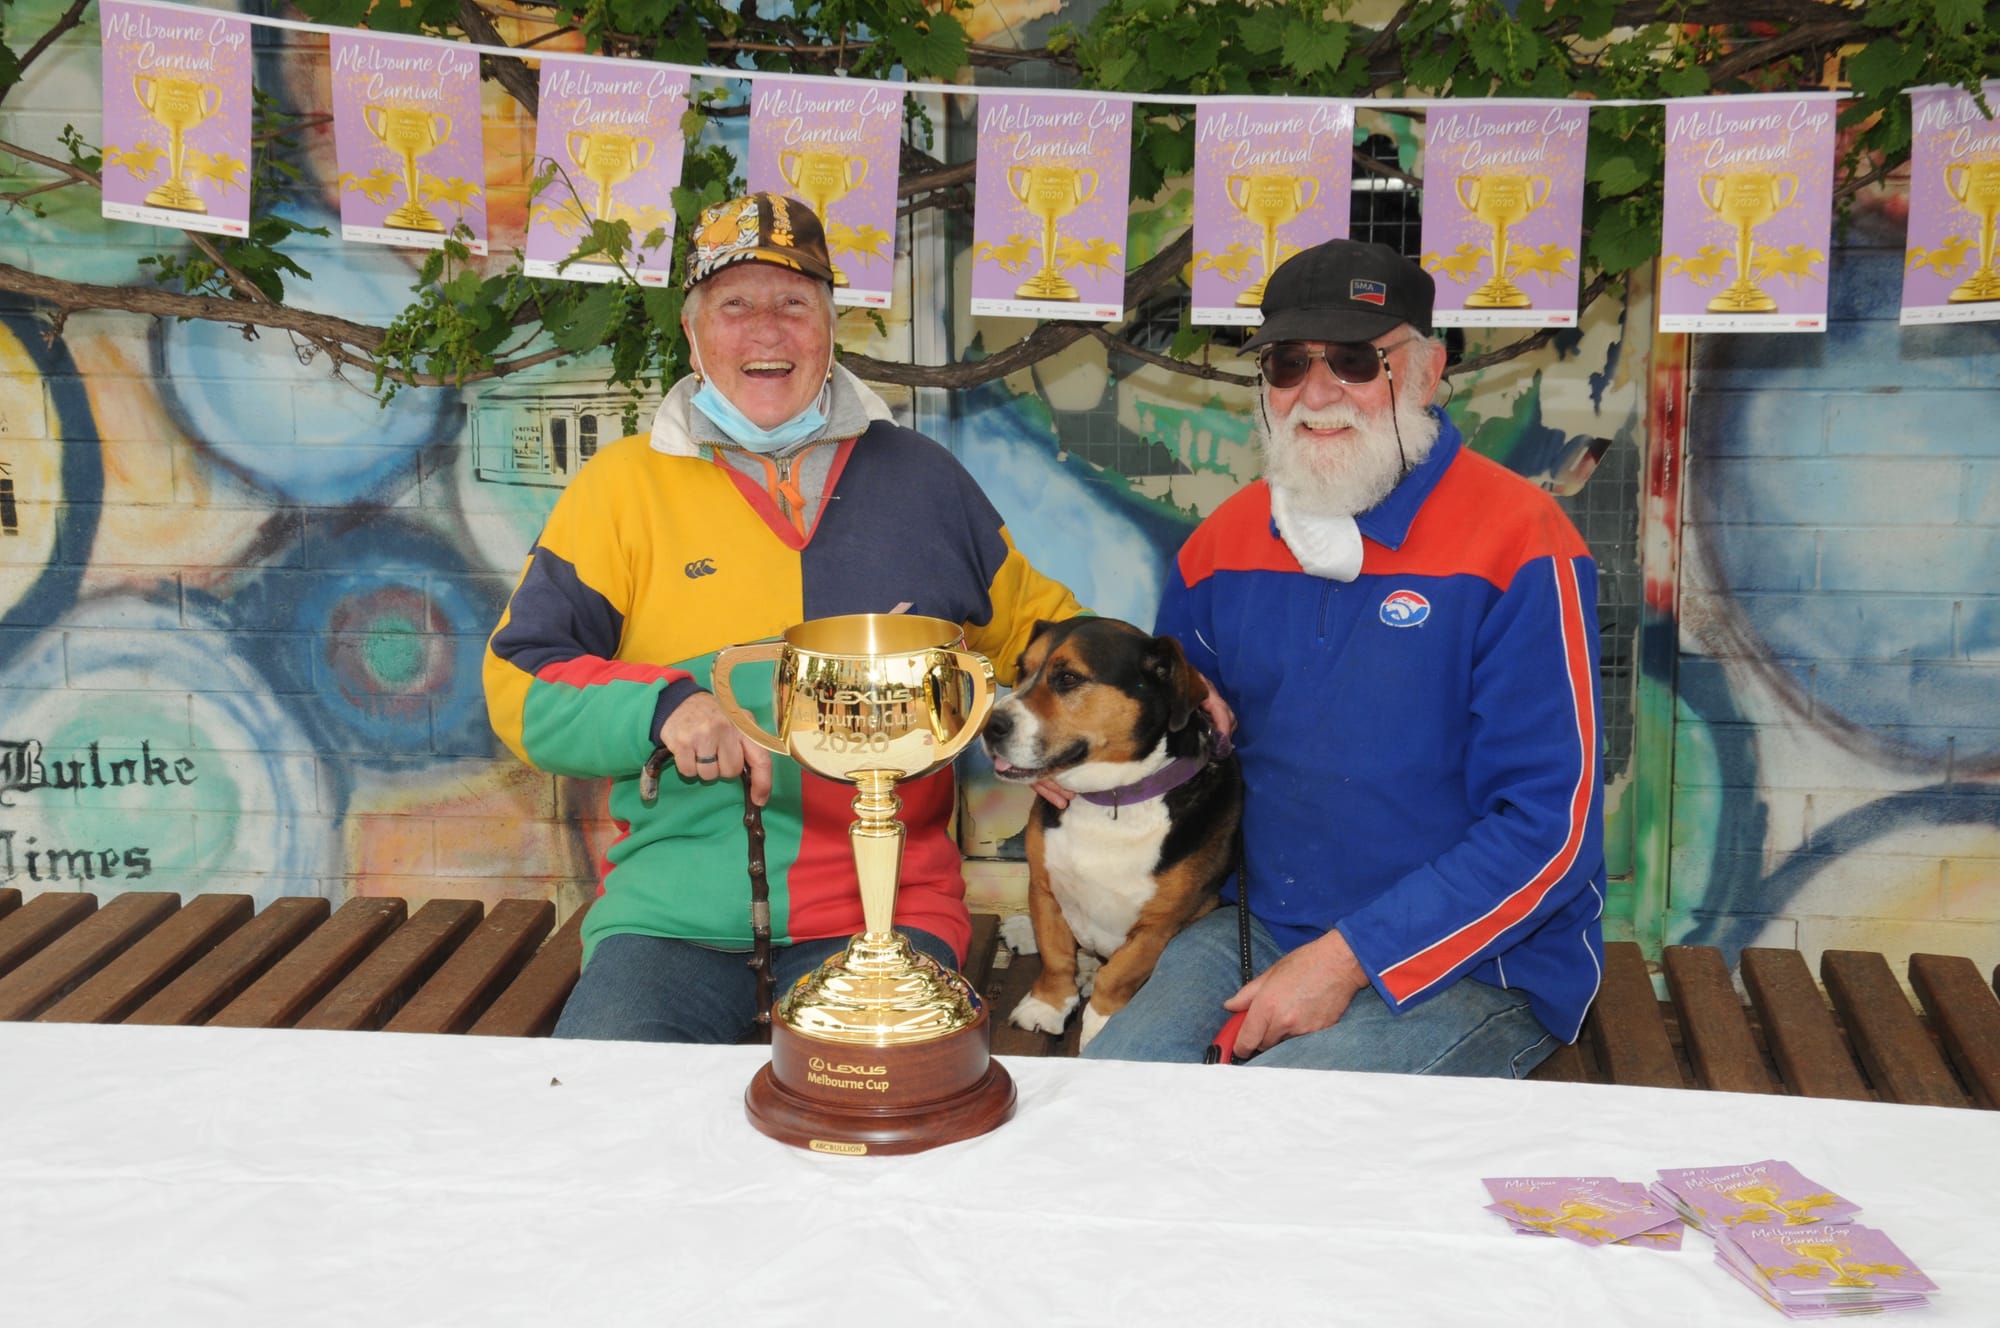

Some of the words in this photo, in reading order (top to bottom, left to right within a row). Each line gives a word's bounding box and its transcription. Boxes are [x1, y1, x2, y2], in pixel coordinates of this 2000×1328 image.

[106, 11, 206, 40] Melbourne
[209, 17, 245, 51] Cup
[137, 41, 216, 71] Carnival
[335, 44, 433, 72] Melbourne
[437, 48, 474, 80] Cup
[367, 72, 444, 100] Carnival
[544, 69, 643, 98] Melbourne
[647, 70, 684, 102] Cup
[572, 97, 652, 126] Carnival
[755, 88, 856, 118] Melbourne
[859, 87, 897, 120] Cup
[983, 104, 1085, 133] Melbourne
[1088, 100, 1126, 132] Cup
[784, 116, 866, 145] Carnival
[1200, 112, 1304, 143] Melbourne
[1431, 114, 1538, 145] Melbourne
[1542, 107, 1583, 138] Cup
[1671, 110, 1782, 143] Melbourne
[1787, 100, 1829, 133] Cup
[1012, 130, 1095, 160] Carnival
[1232, 136, 1315, 169] Carnival
[1462, 137, 1548, 169] Carnival
[1704, 132, 1794, 168] Carnival
[819, 688, 913, 705] LEXUS
[812, 730, 889, 754] 2020
[808, 1072, 864, 1090] Melbourne
[866, 1079, 889, 1092] Cup
[827, 1062, 888, 1075] LEXUS
